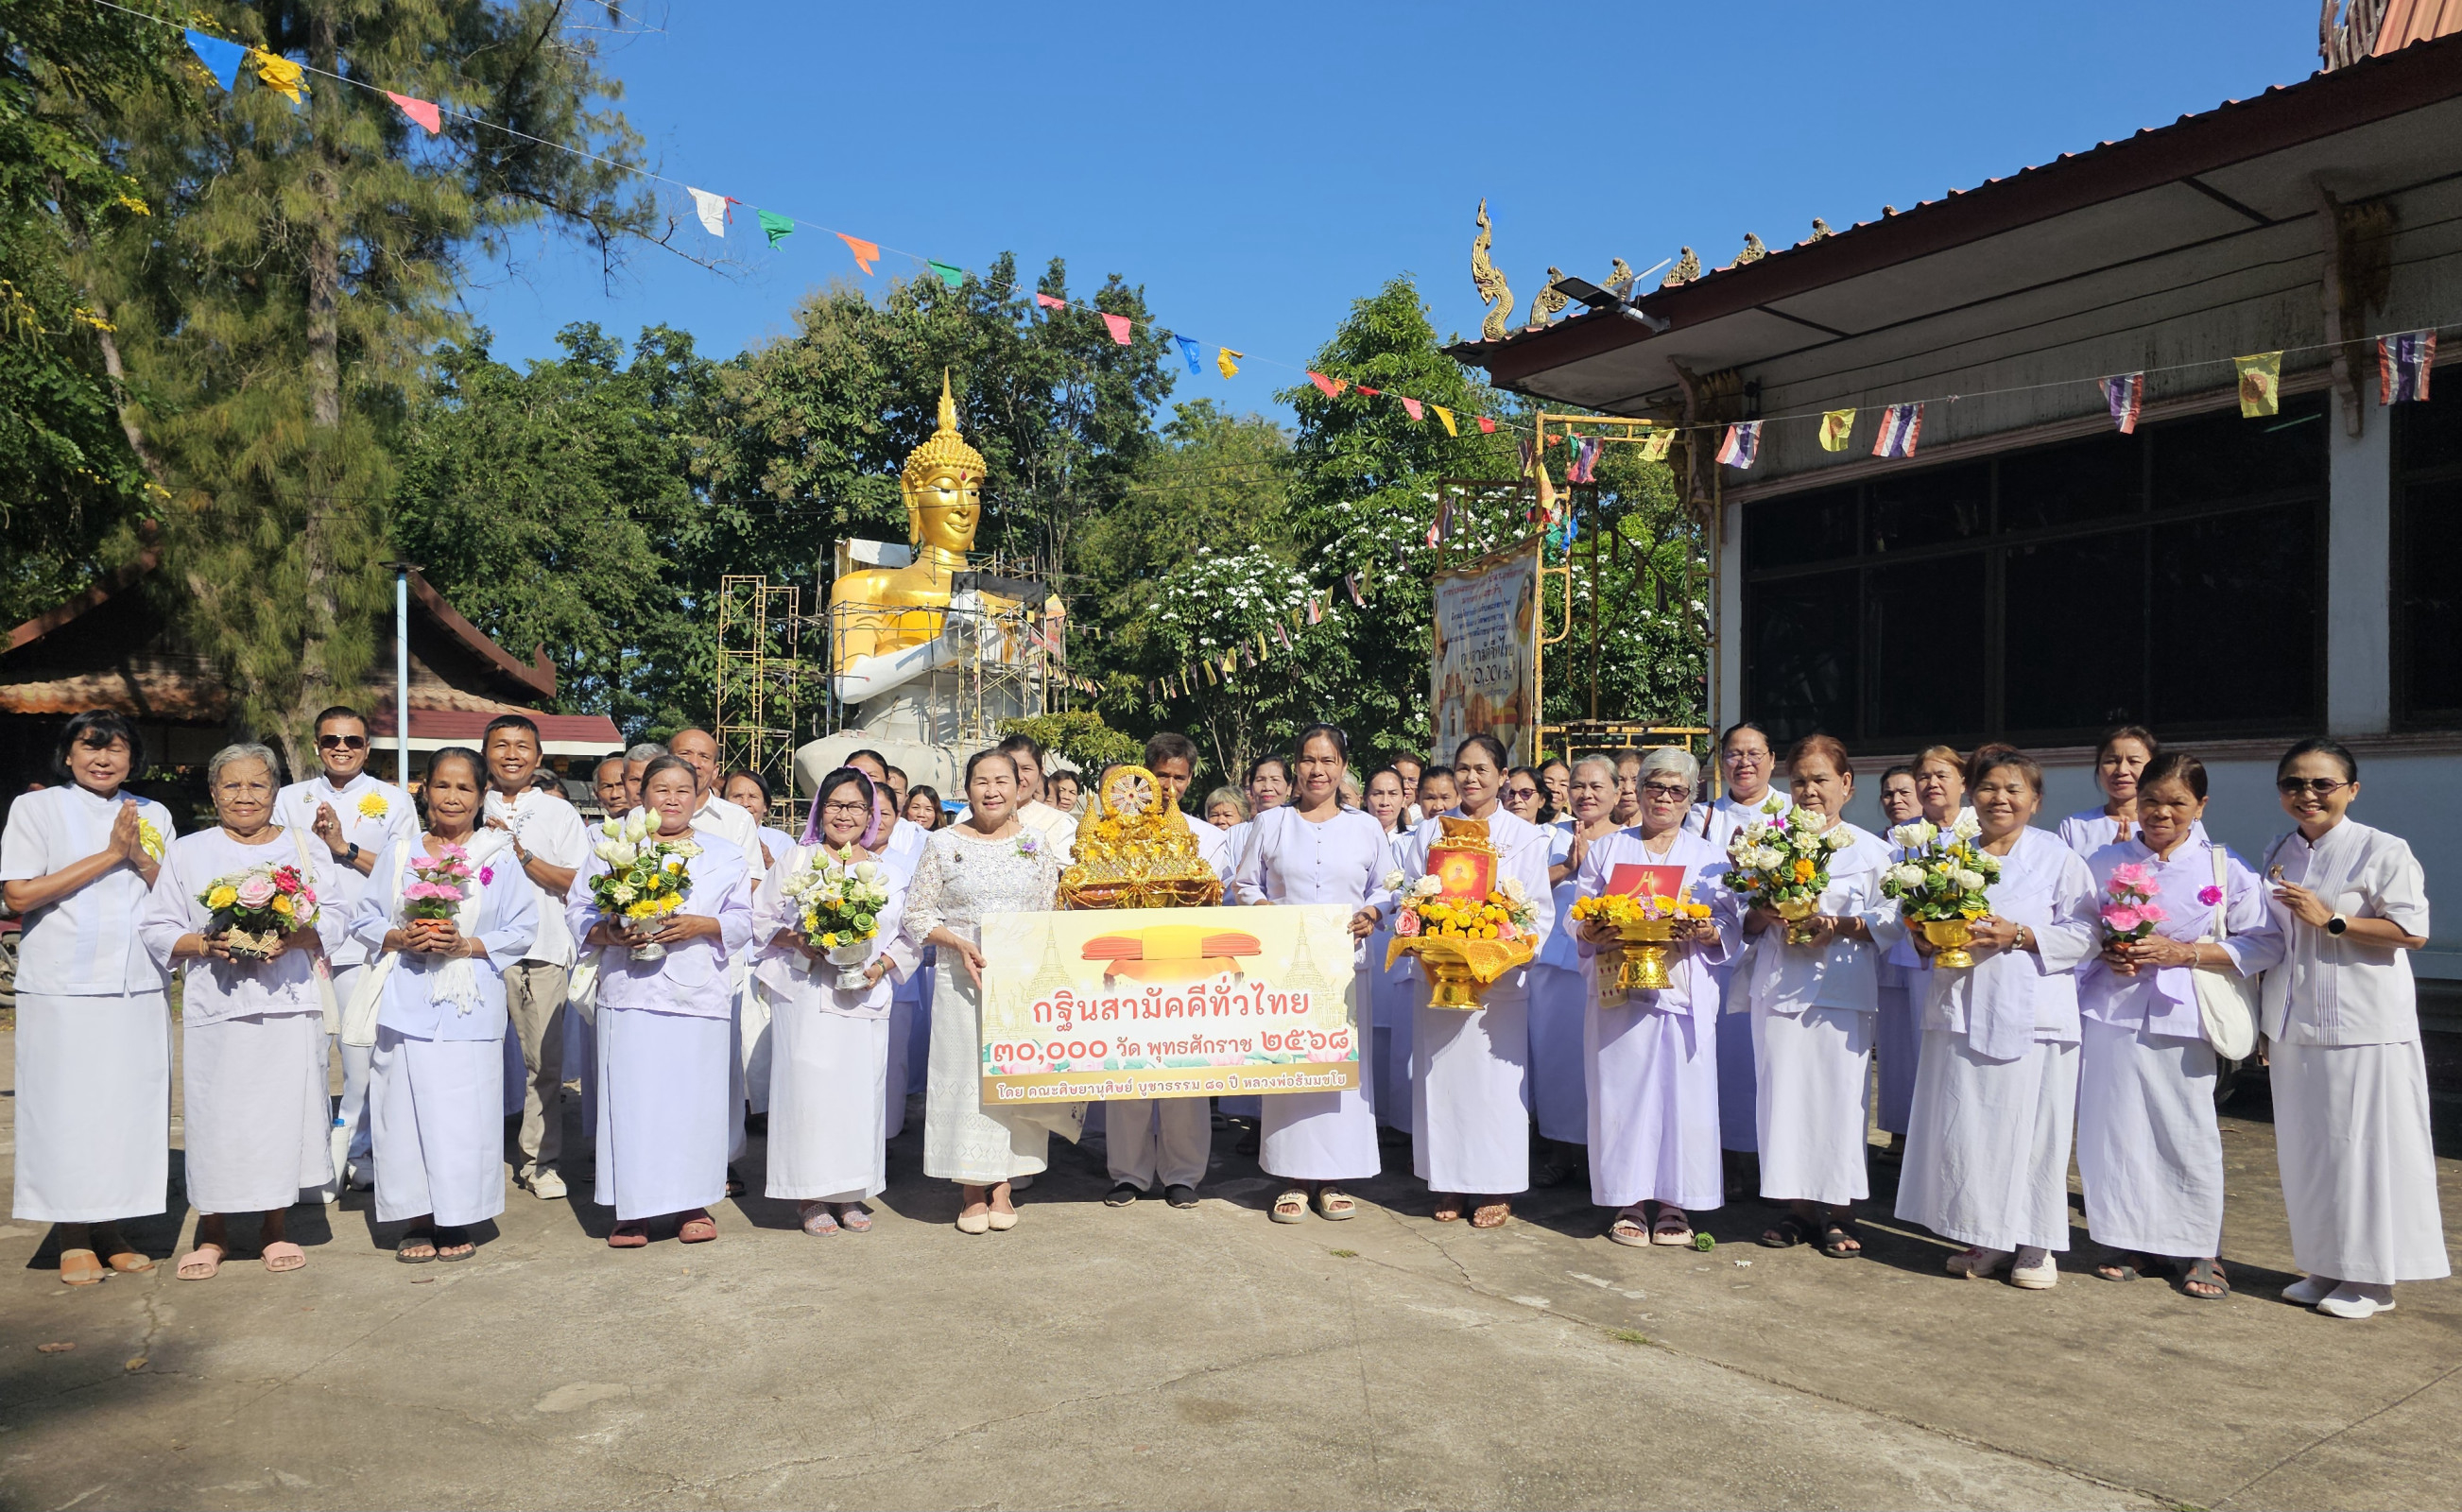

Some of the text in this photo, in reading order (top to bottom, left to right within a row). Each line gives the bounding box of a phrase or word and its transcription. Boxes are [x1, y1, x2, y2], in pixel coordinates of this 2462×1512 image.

[1033, 975, 1309, 1032] กฐินสามัคคีทั่วไทย
[993, 1028, 1350, 1065] ๓๐,๐๐๐ วัด พุทธศักราช ๒๕๖๘
[998, 1084, 1024, 1098] โดย
[1028, 1078, 1133, 1098] คณะศิษยานุศิษย์
[1138, 1081, 1200, 1096] บูชาธรรม
[1205, 1079, 1224, 1091] ๘๑
[1229, 1075, 1238, 1089] ปี
